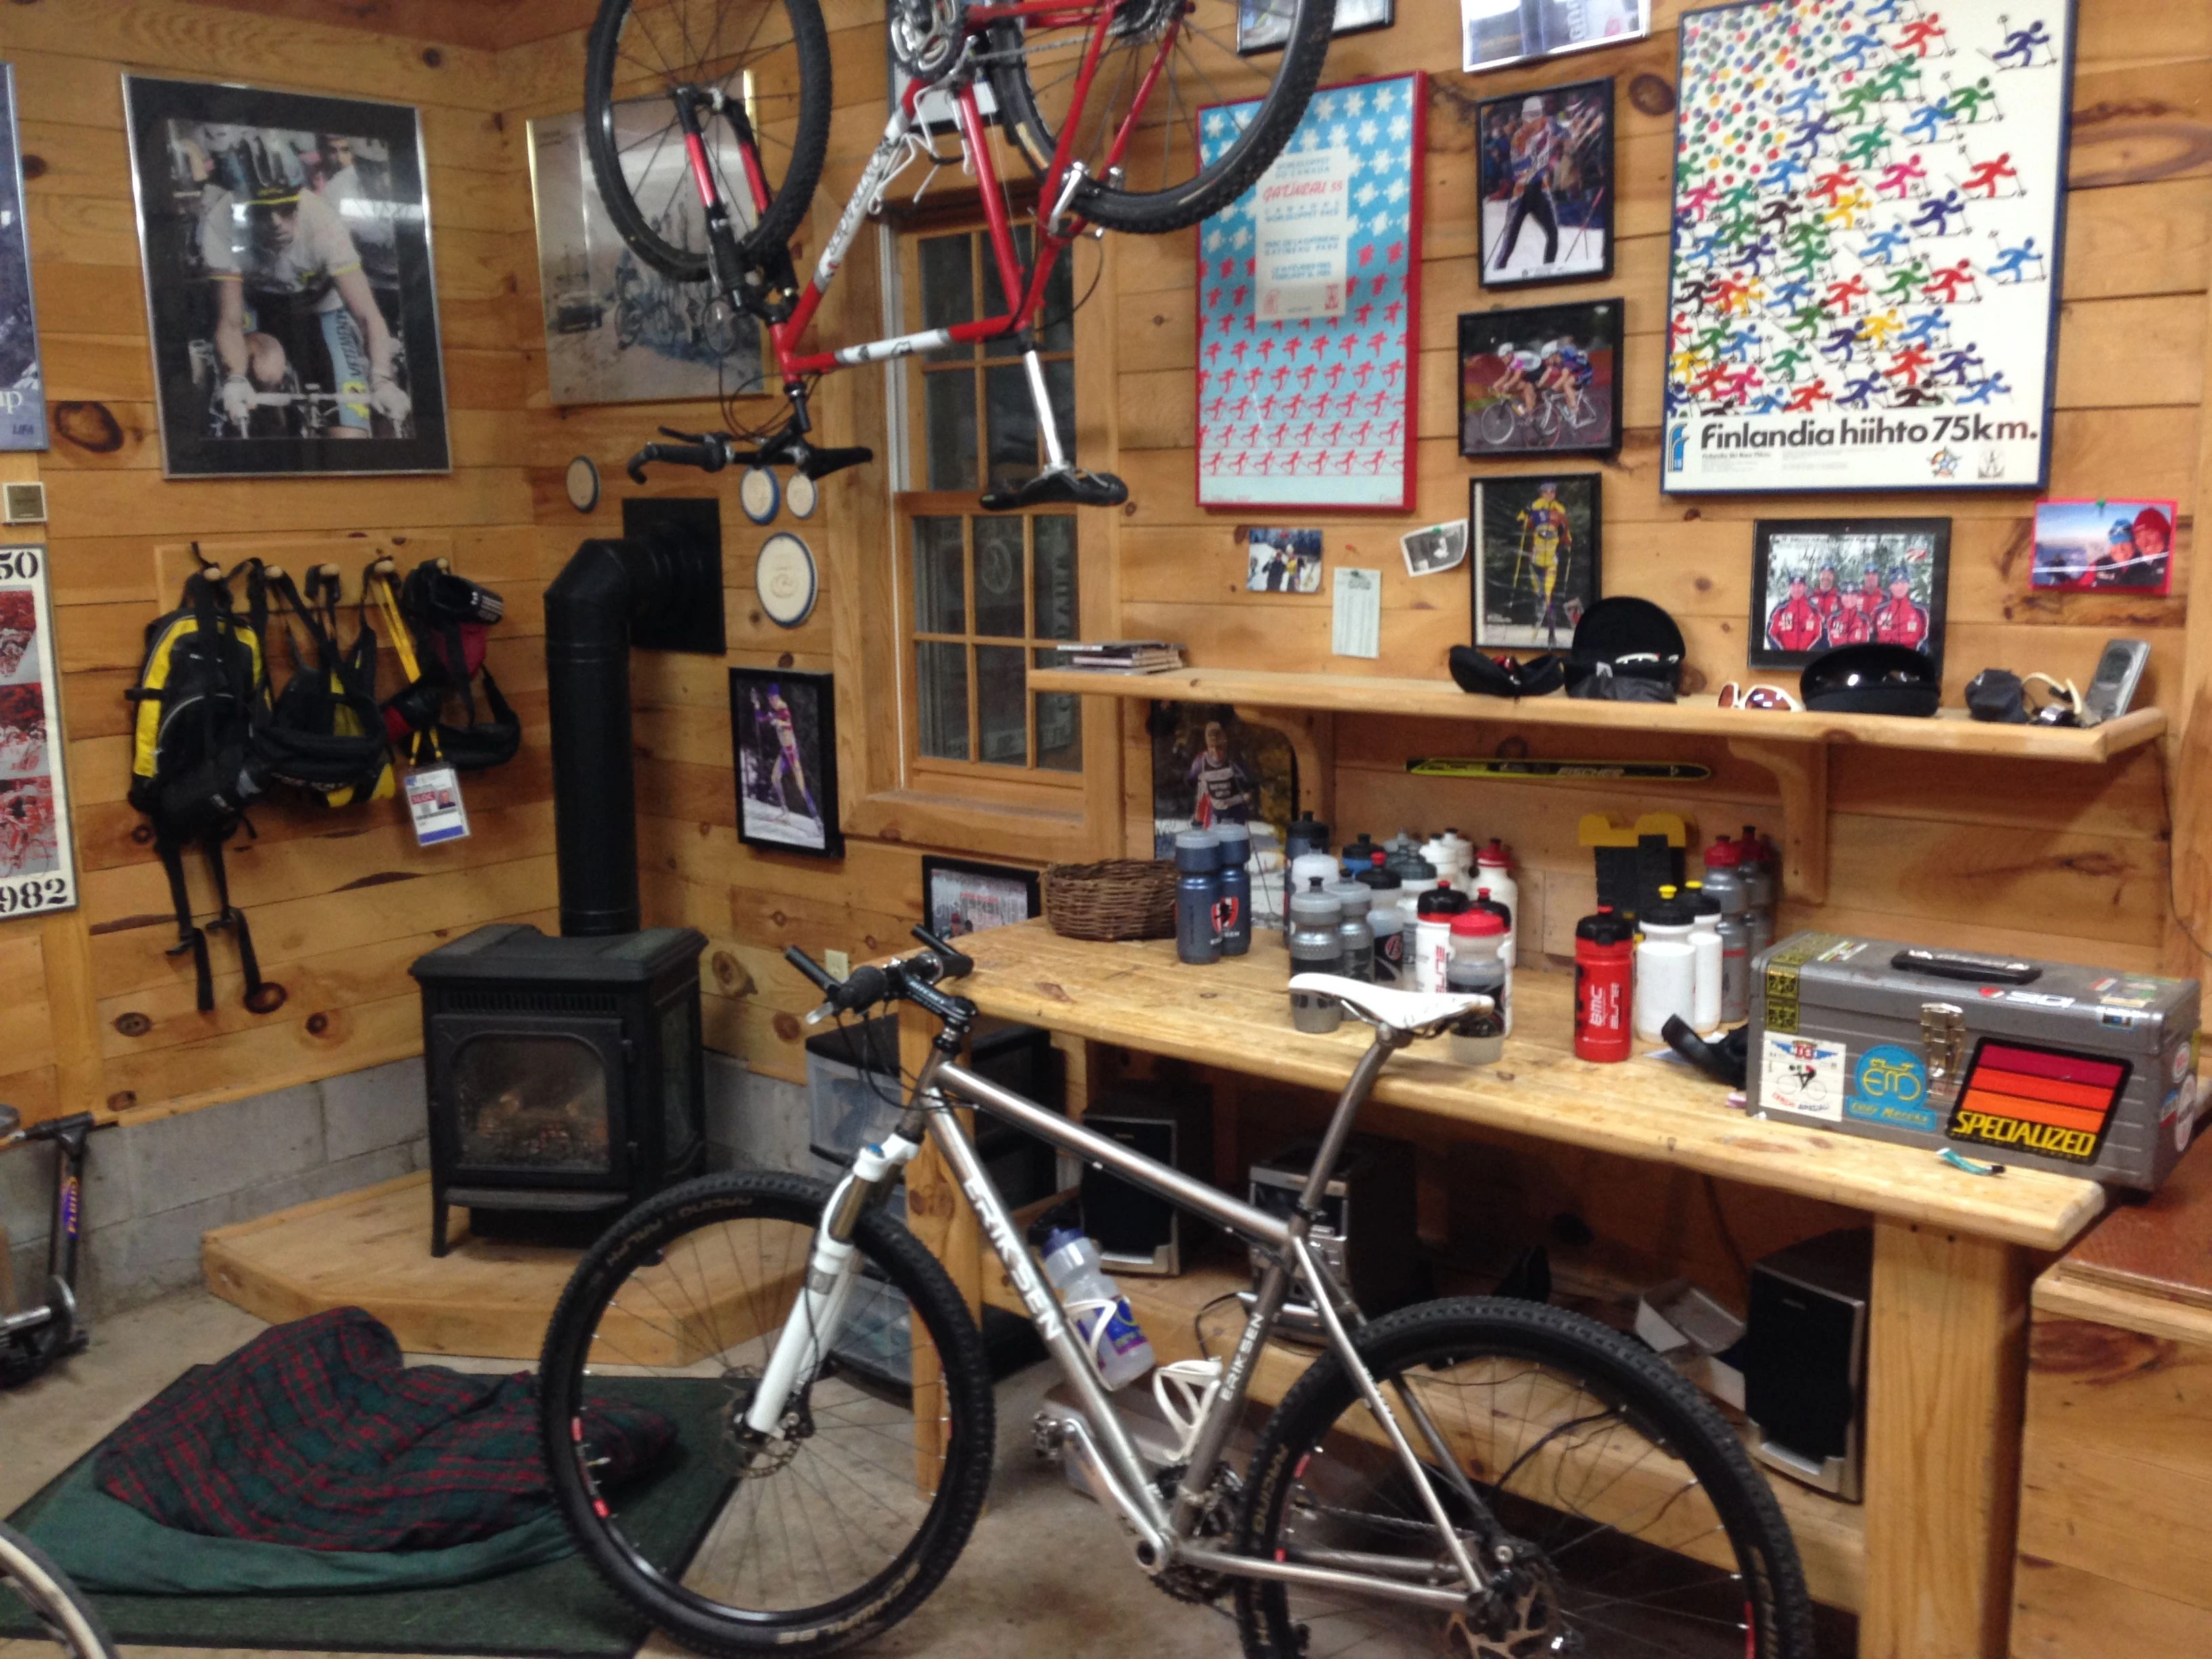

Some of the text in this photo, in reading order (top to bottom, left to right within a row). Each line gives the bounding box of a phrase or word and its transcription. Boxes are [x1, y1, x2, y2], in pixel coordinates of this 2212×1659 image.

[1840, 417, 1929, 445] hiihto
[1950, 1109, 2097, 1157] SPECIALIZED
[964, 1176, 1065, 1340] ERIKSEN
[1219, 1312, 1265, 1402] ERIKSEN
